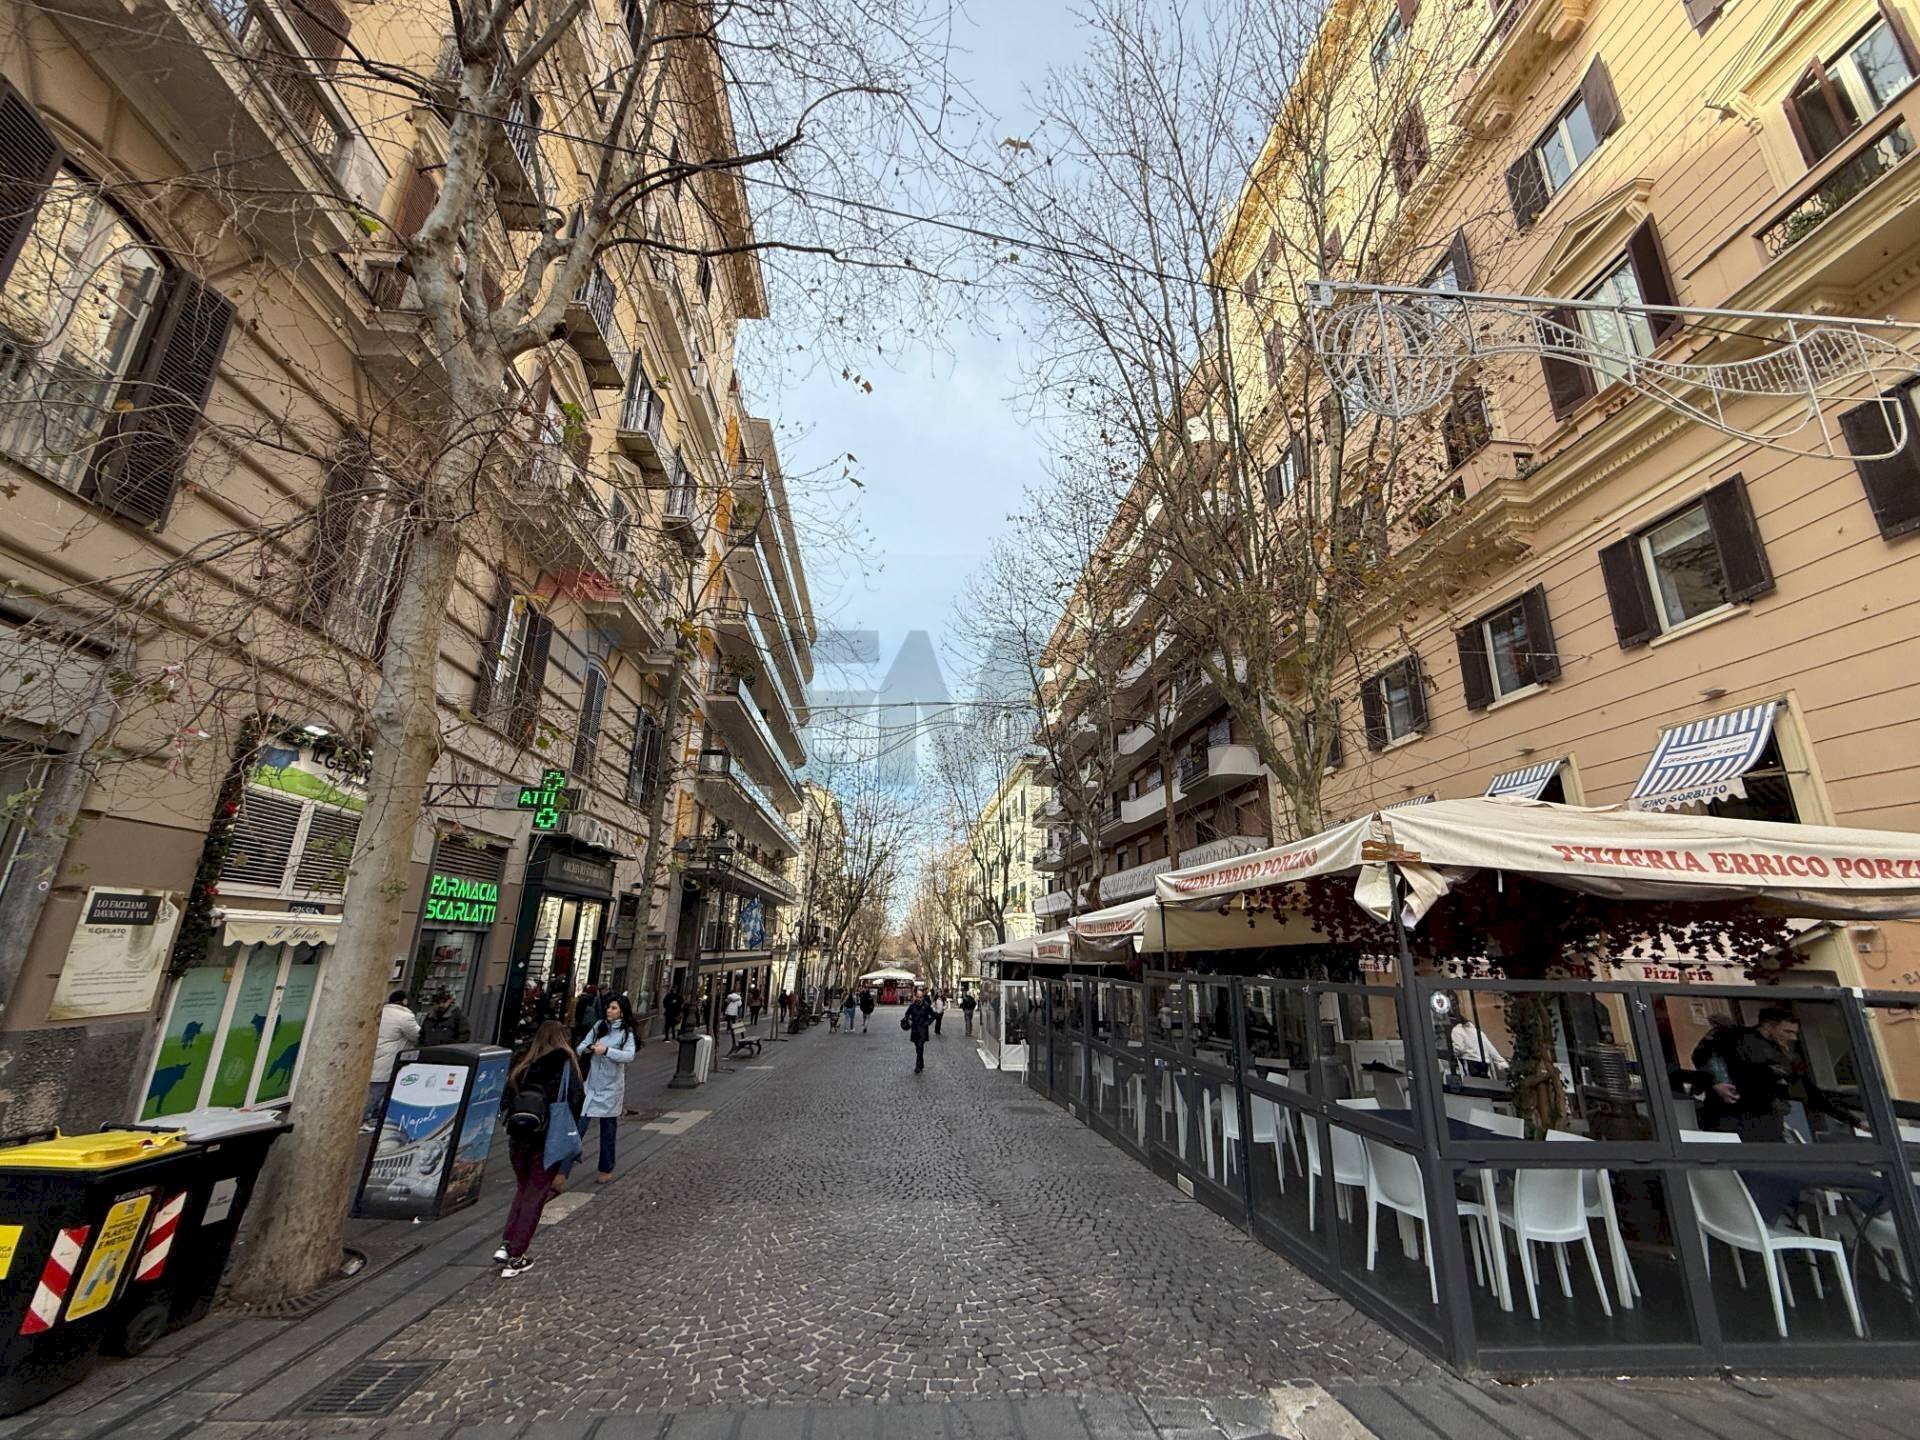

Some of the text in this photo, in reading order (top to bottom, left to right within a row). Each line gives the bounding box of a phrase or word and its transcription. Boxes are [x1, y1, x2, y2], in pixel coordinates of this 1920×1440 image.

[520, 790, 556, 805] ATTI
[1641, 784, 1728, 809] GINO SORBILLO
[1174, 847, 1318, 893] PIZZERIA ERRICO PORZIO
[1551, 845, 1709, 873] PIZZERIA
[1708, 852, 1830, 878] ERRICO
[430, 874, 498, 902] FARMACIA
[93, 909, 128, 918] DAVANTI
[96, 899, 148, 910] LO FACCIAMO
[424, 899, 497, 922] SCARLATTI
[289, 926, 321, 940] Gelato
[1643, 966, 1715, 983] Pizzria
[400, 1105, 438, 1134] Napoli
[103, 1222, 138, 1239] PLASTICA
